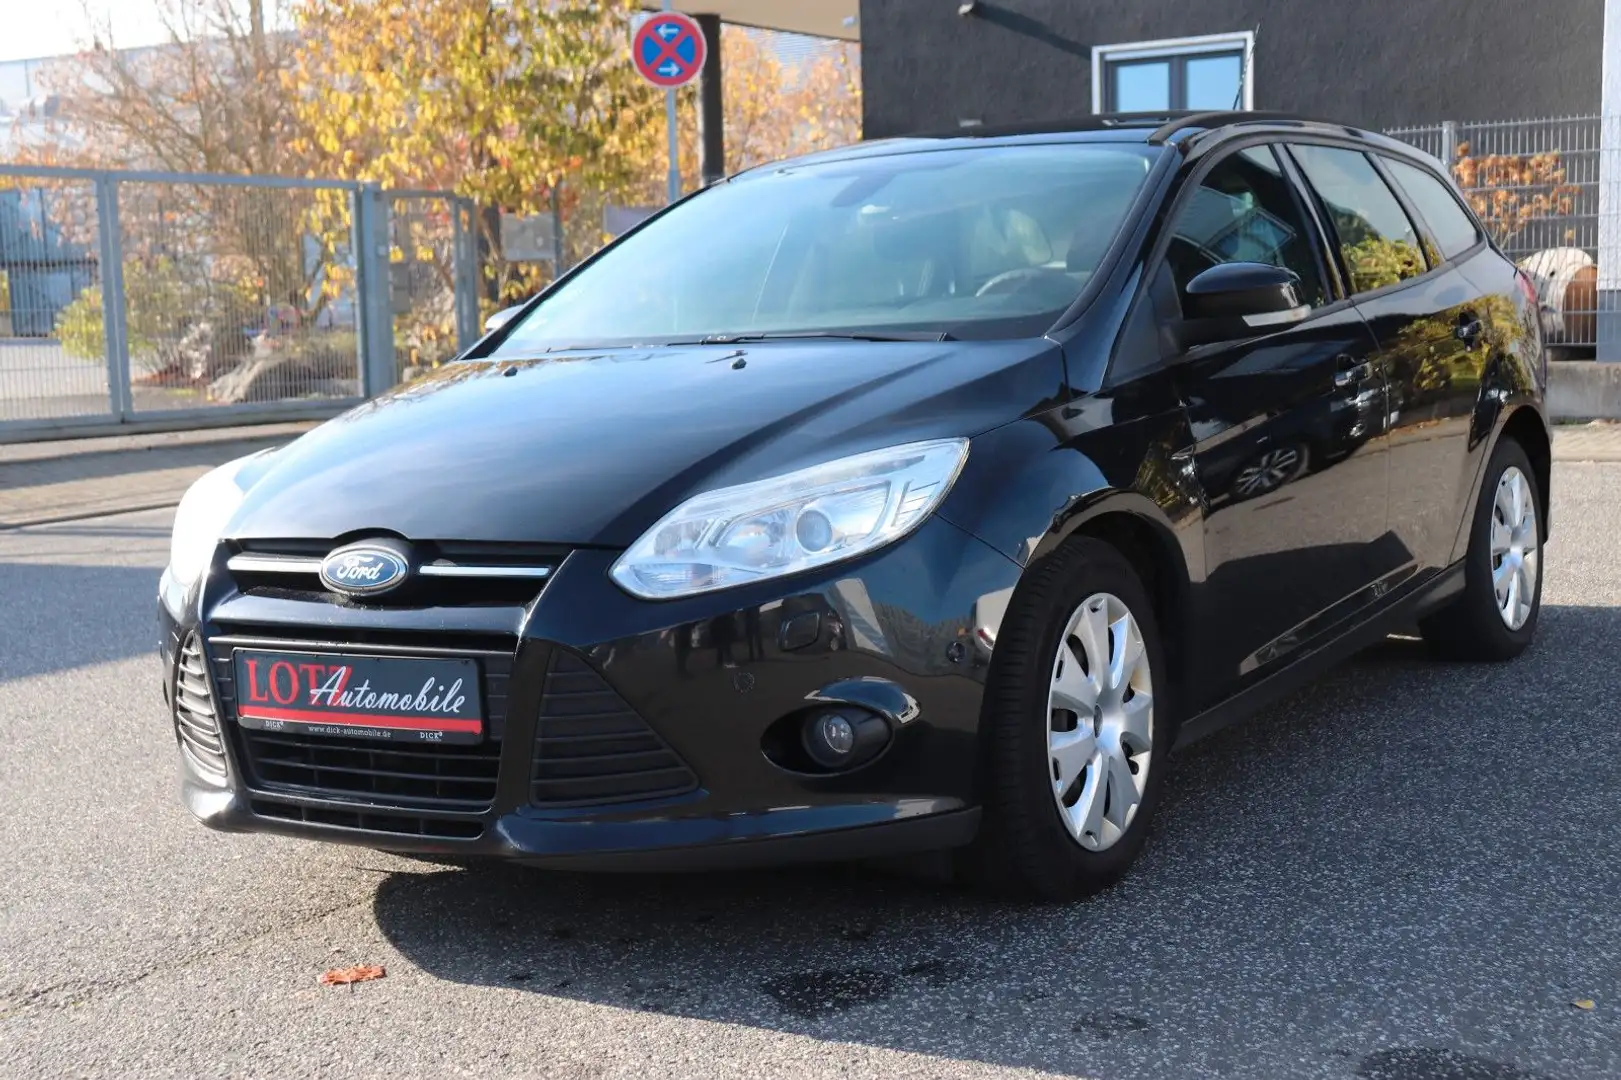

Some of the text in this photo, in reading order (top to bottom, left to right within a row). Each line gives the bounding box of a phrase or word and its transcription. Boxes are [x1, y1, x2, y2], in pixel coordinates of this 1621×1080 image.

[336, 555, 385, 580] Ford
[244, 658, 354, 706] LOTZ
[310, 665, 465, 713] Automobile
[307, 726, 391, 738] www.dick-automobile.de
